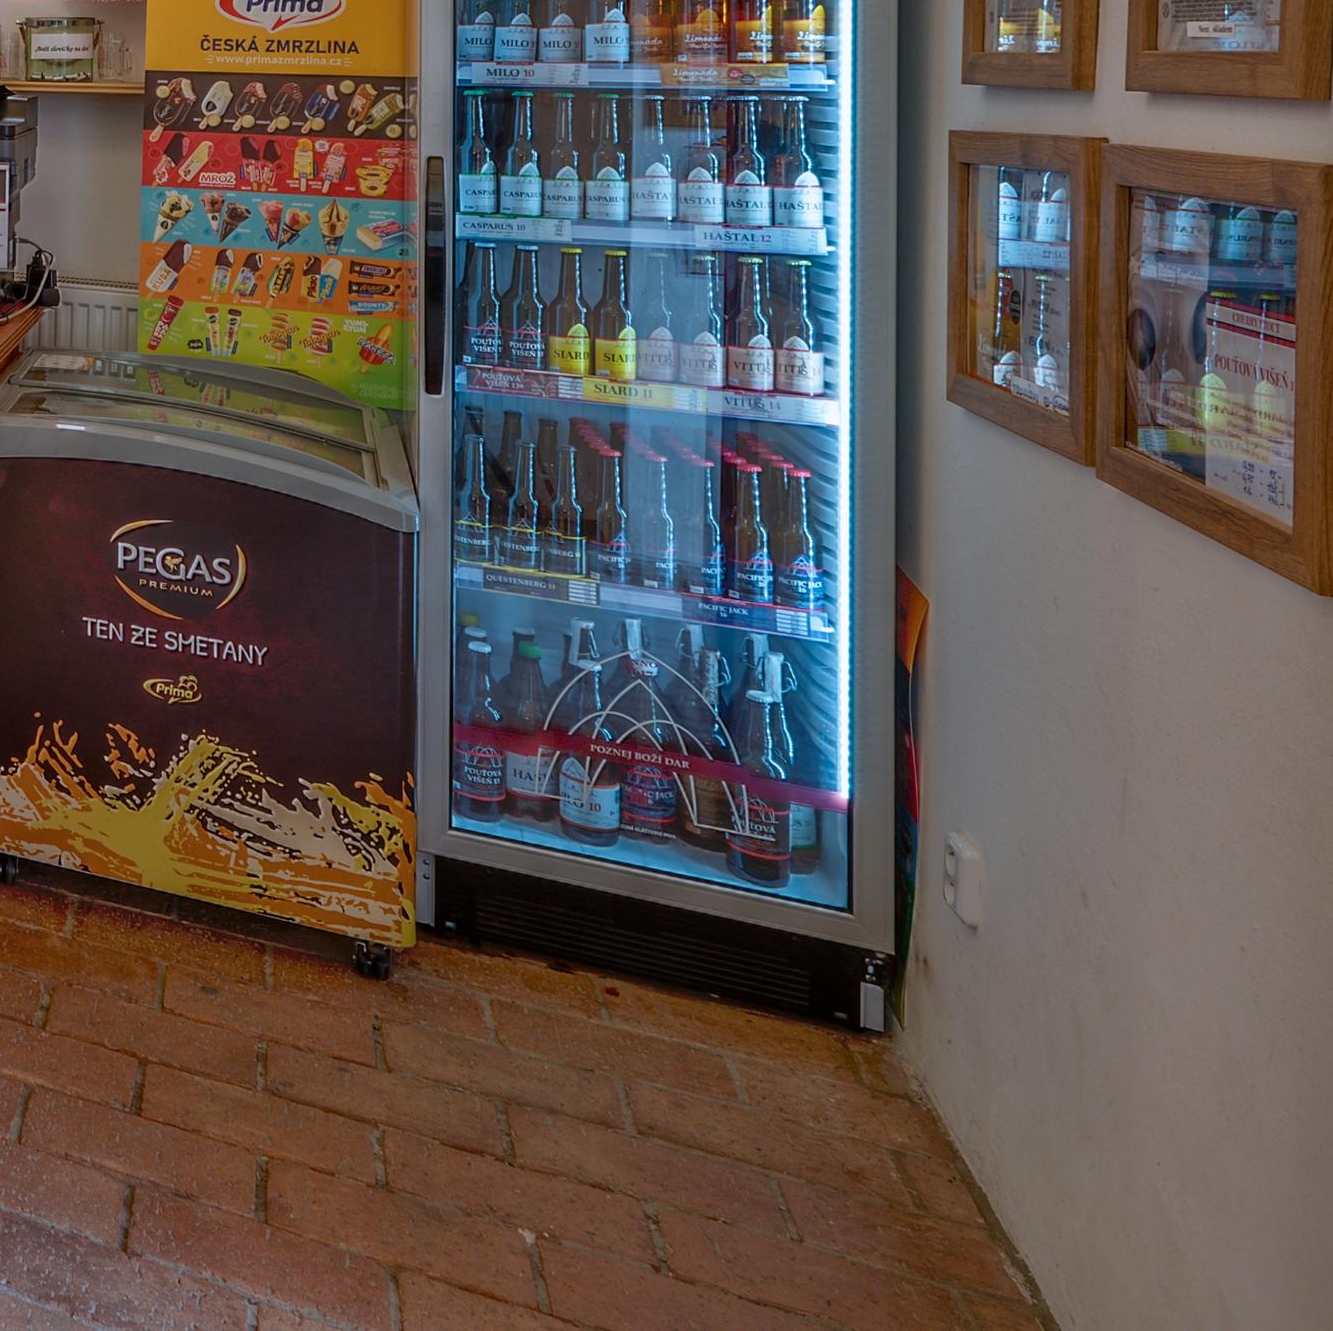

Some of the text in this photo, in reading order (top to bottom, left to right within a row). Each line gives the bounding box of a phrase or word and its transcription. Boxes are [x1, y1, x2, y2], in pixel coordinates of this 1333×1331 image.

[201, 34, 359, 54] ČESKÁ ZMRZLINA
[464, 36, 493, 47] MILO
[500, 37, 530, 49] MILO
[542, 38, 572, 50] MILO
[593, 34, 625, 46] MILO
[216, 54, 342, 67] www.primazmrzlina.cz
[486, 68, 534, 78] MILO 10
[462, 221, 526, 232] CASPARUS 10
[703, 228, 772, 243] HAŠTAL 12
[1214, 353, 1289, 393] POUŤOVÁ VIŠEŇ
[594, 382, 638, 397] SIARD
[724, 396, 765, 408] VITUS
[117, 541, 232, 585] PEGAS
[139, 579, 213, 598] PREMIUM
[486, 573, 547, 589] QUESTENBERG
[698, 602, 748, 616] PACIFIC JACK
[83, 617, 268, 666] TEN ZE SMETANY
[155, 683, 193, 700] Prima
[590, 744, 690, 770] POZNEJ BOŽÍ DAR
